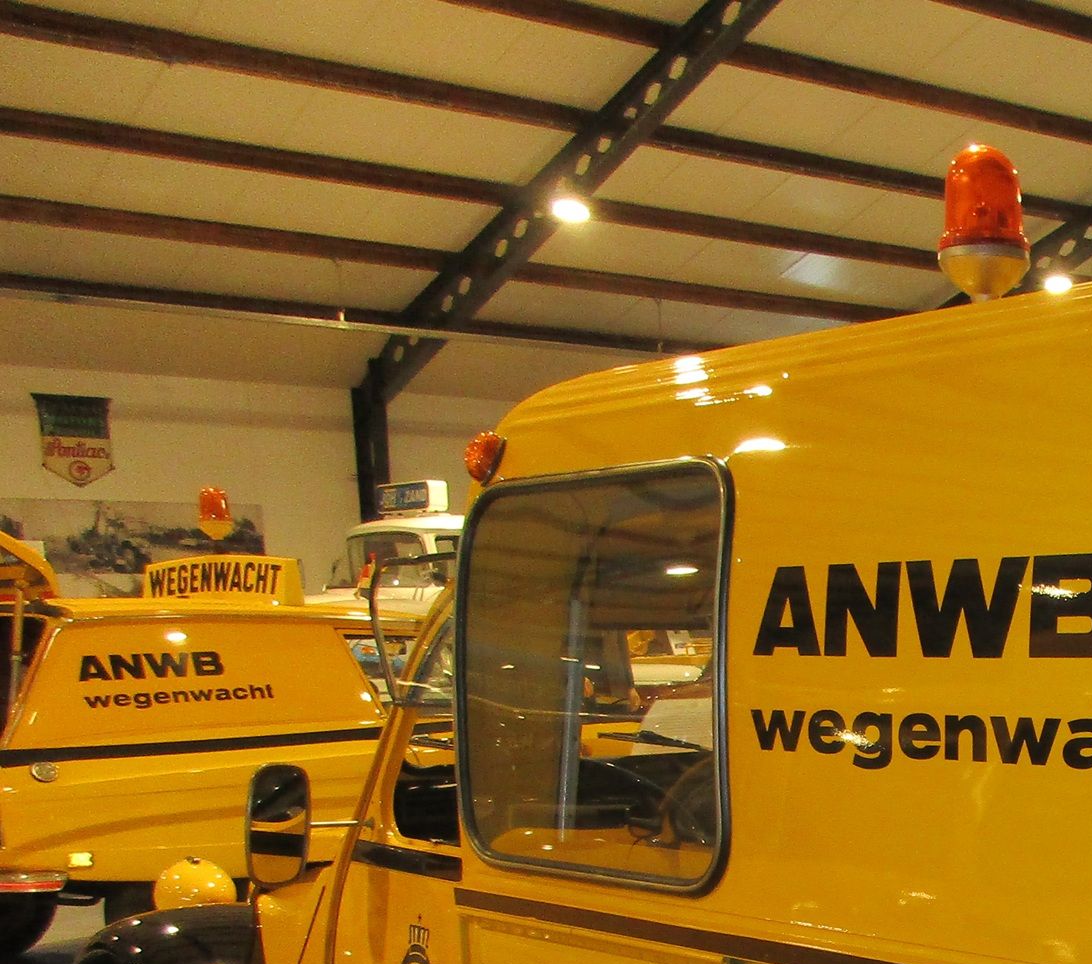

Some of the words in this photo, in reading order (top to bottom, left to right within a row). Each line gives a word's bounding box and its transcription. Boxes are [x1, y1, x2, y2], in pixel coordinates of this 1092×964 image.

[148, 561, 282, 598] WEGENWACHT
[78, 650, 225, 683] ANWB
[84, 683, 274, 709] wegenwacht
